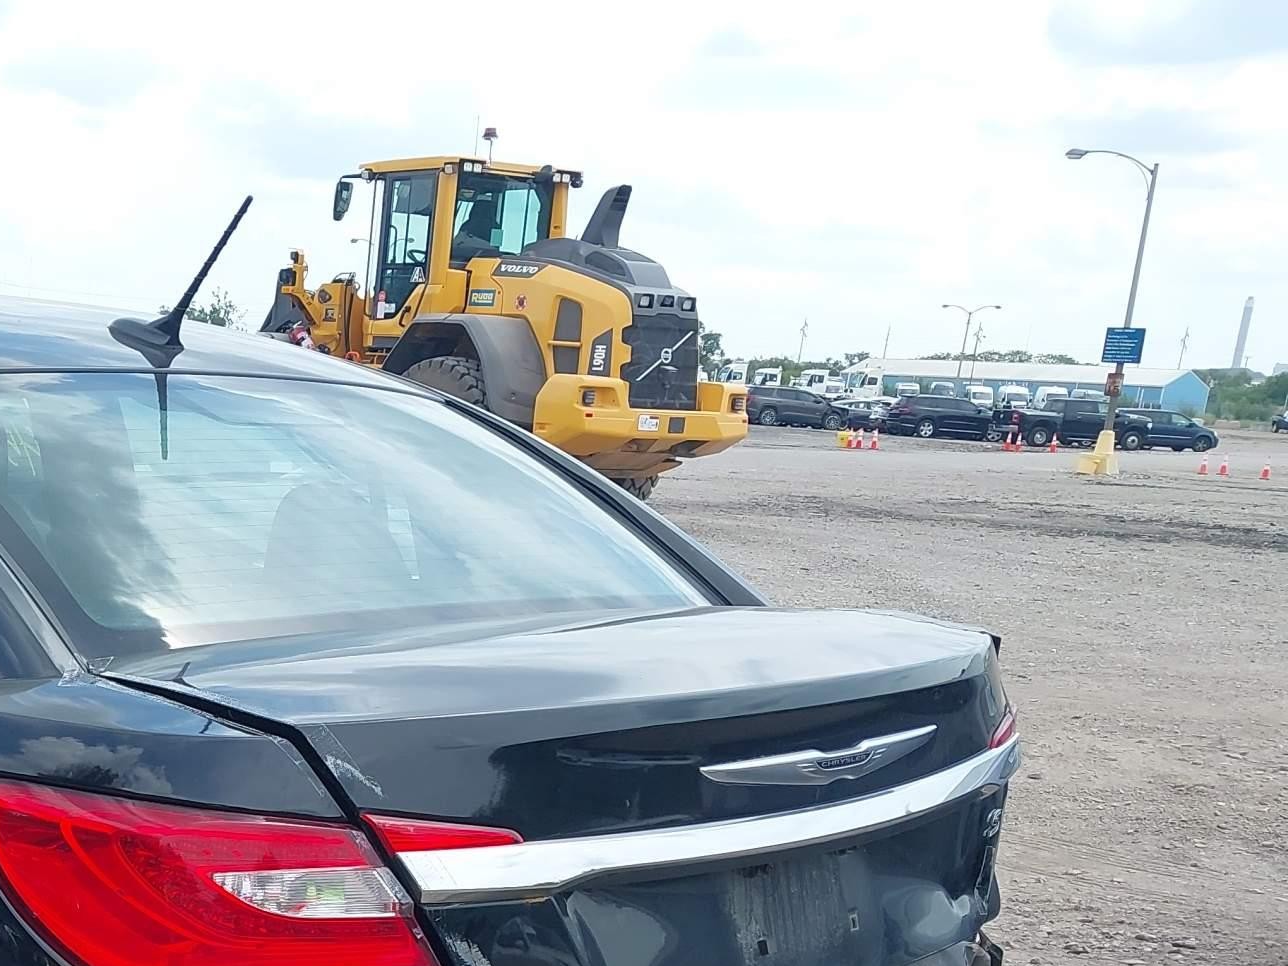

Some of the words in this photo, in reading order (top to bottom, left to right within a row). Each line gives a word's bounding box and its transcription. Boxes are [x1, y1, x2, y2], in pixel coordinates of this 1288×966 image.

[500, 264, 539, 274] VOLVO
[591, 345, 607, 371] L90H
[821, 754, 868, 768] CHRYSLER
